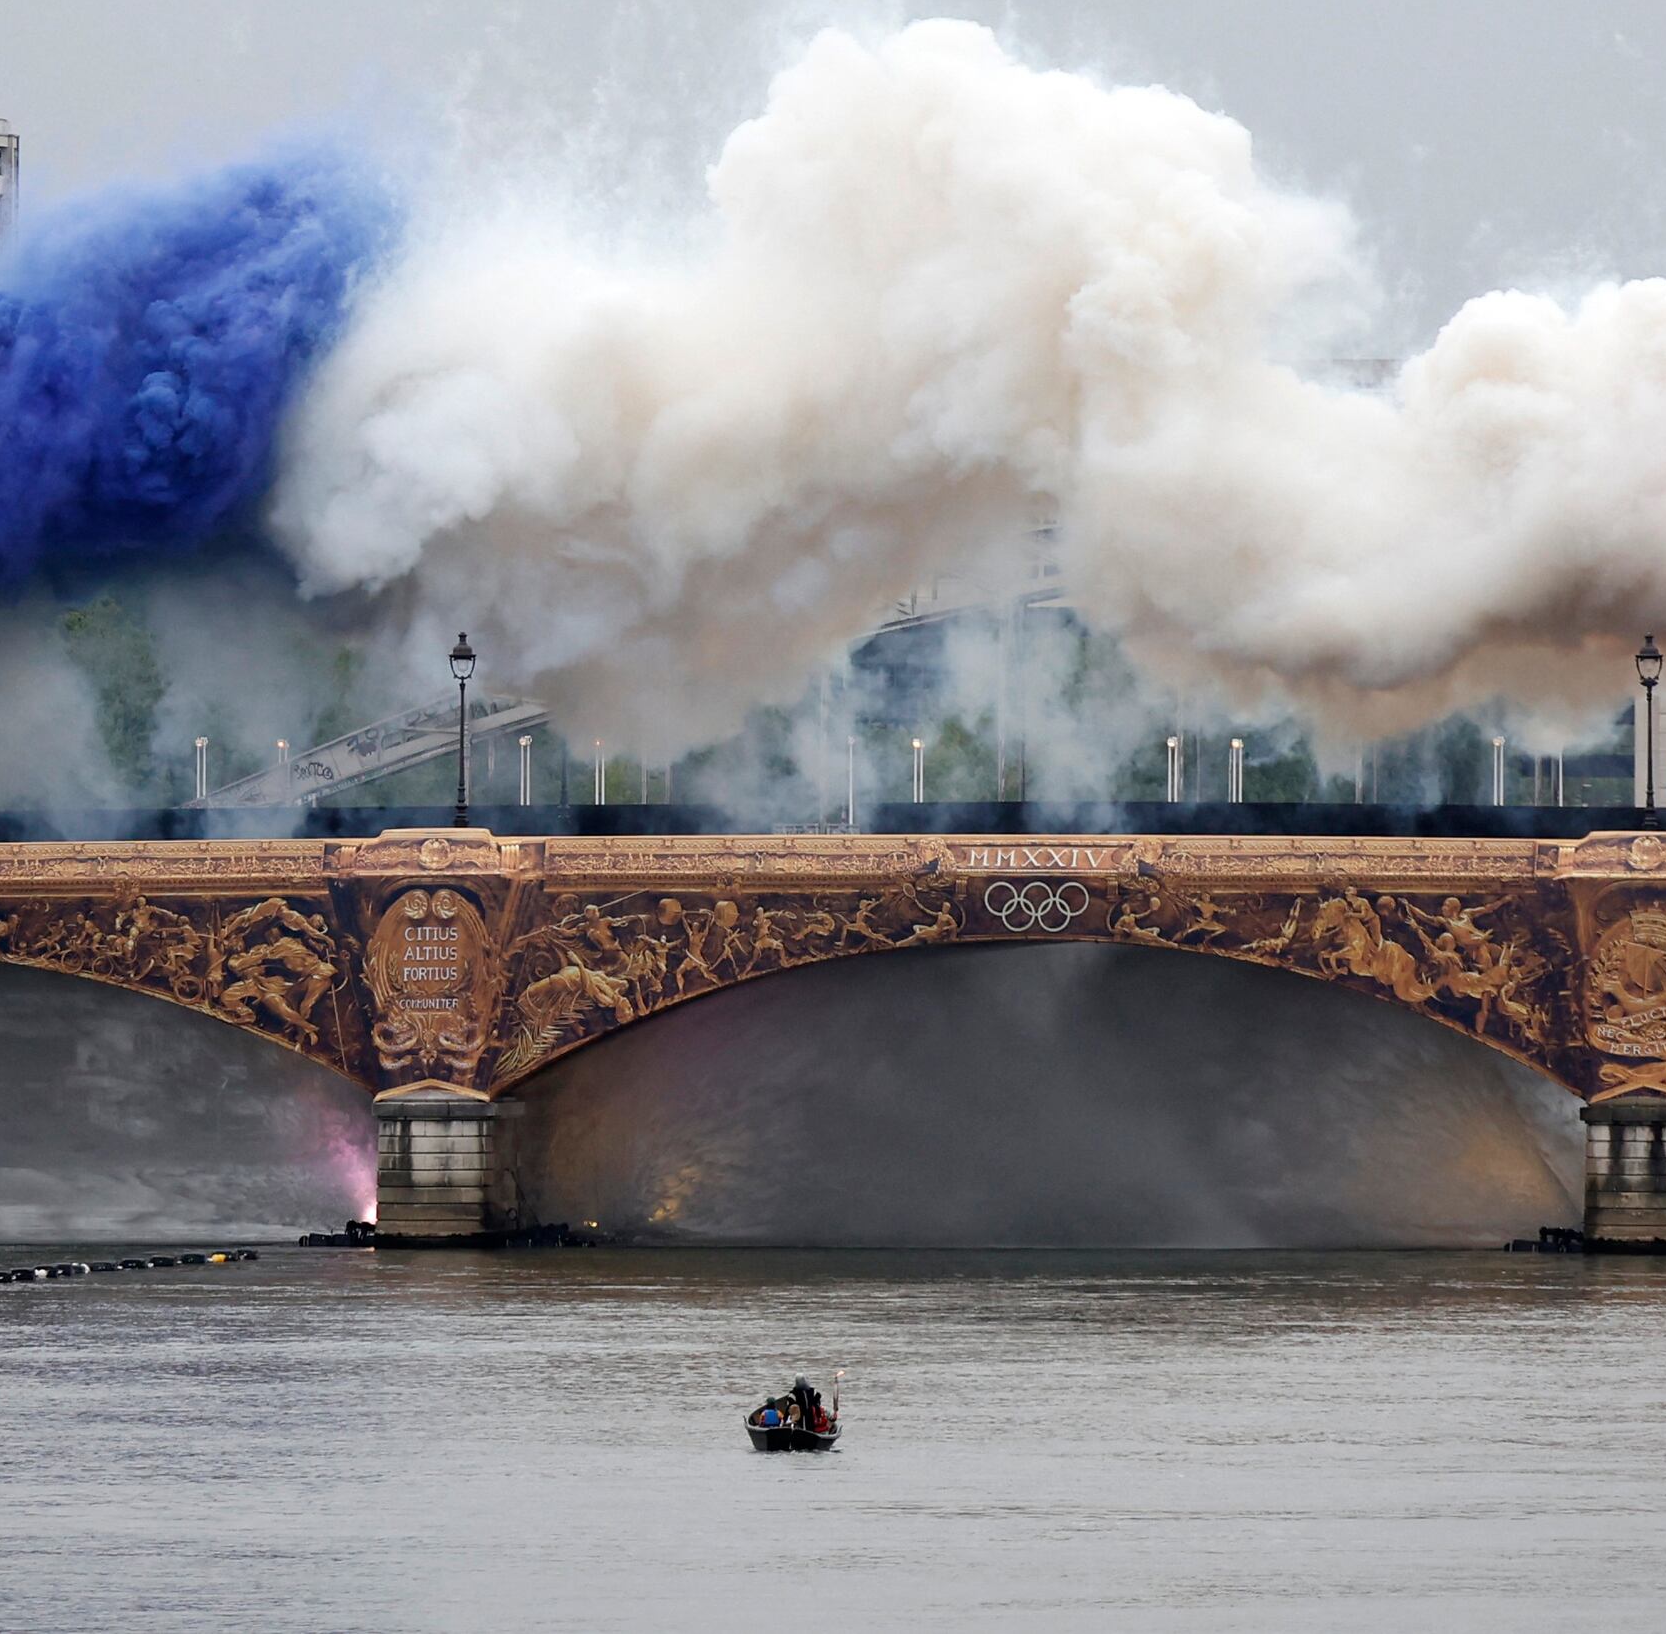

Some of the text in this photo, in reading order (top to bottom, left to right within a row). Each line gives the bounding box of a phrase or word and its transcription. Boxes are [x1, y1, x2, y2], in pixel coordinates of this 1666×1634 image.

[967, 848, 1108, 868] MMXXIV
[404, 926, 459, 942] CITIUS
[403, 946, 458, 961] ALTIUS
[403, 967, 458, 982] FORTIUS
[399, 998, 459, 1010] COMMUNITER
[1597, 1026, 1625, 1041] NEC
